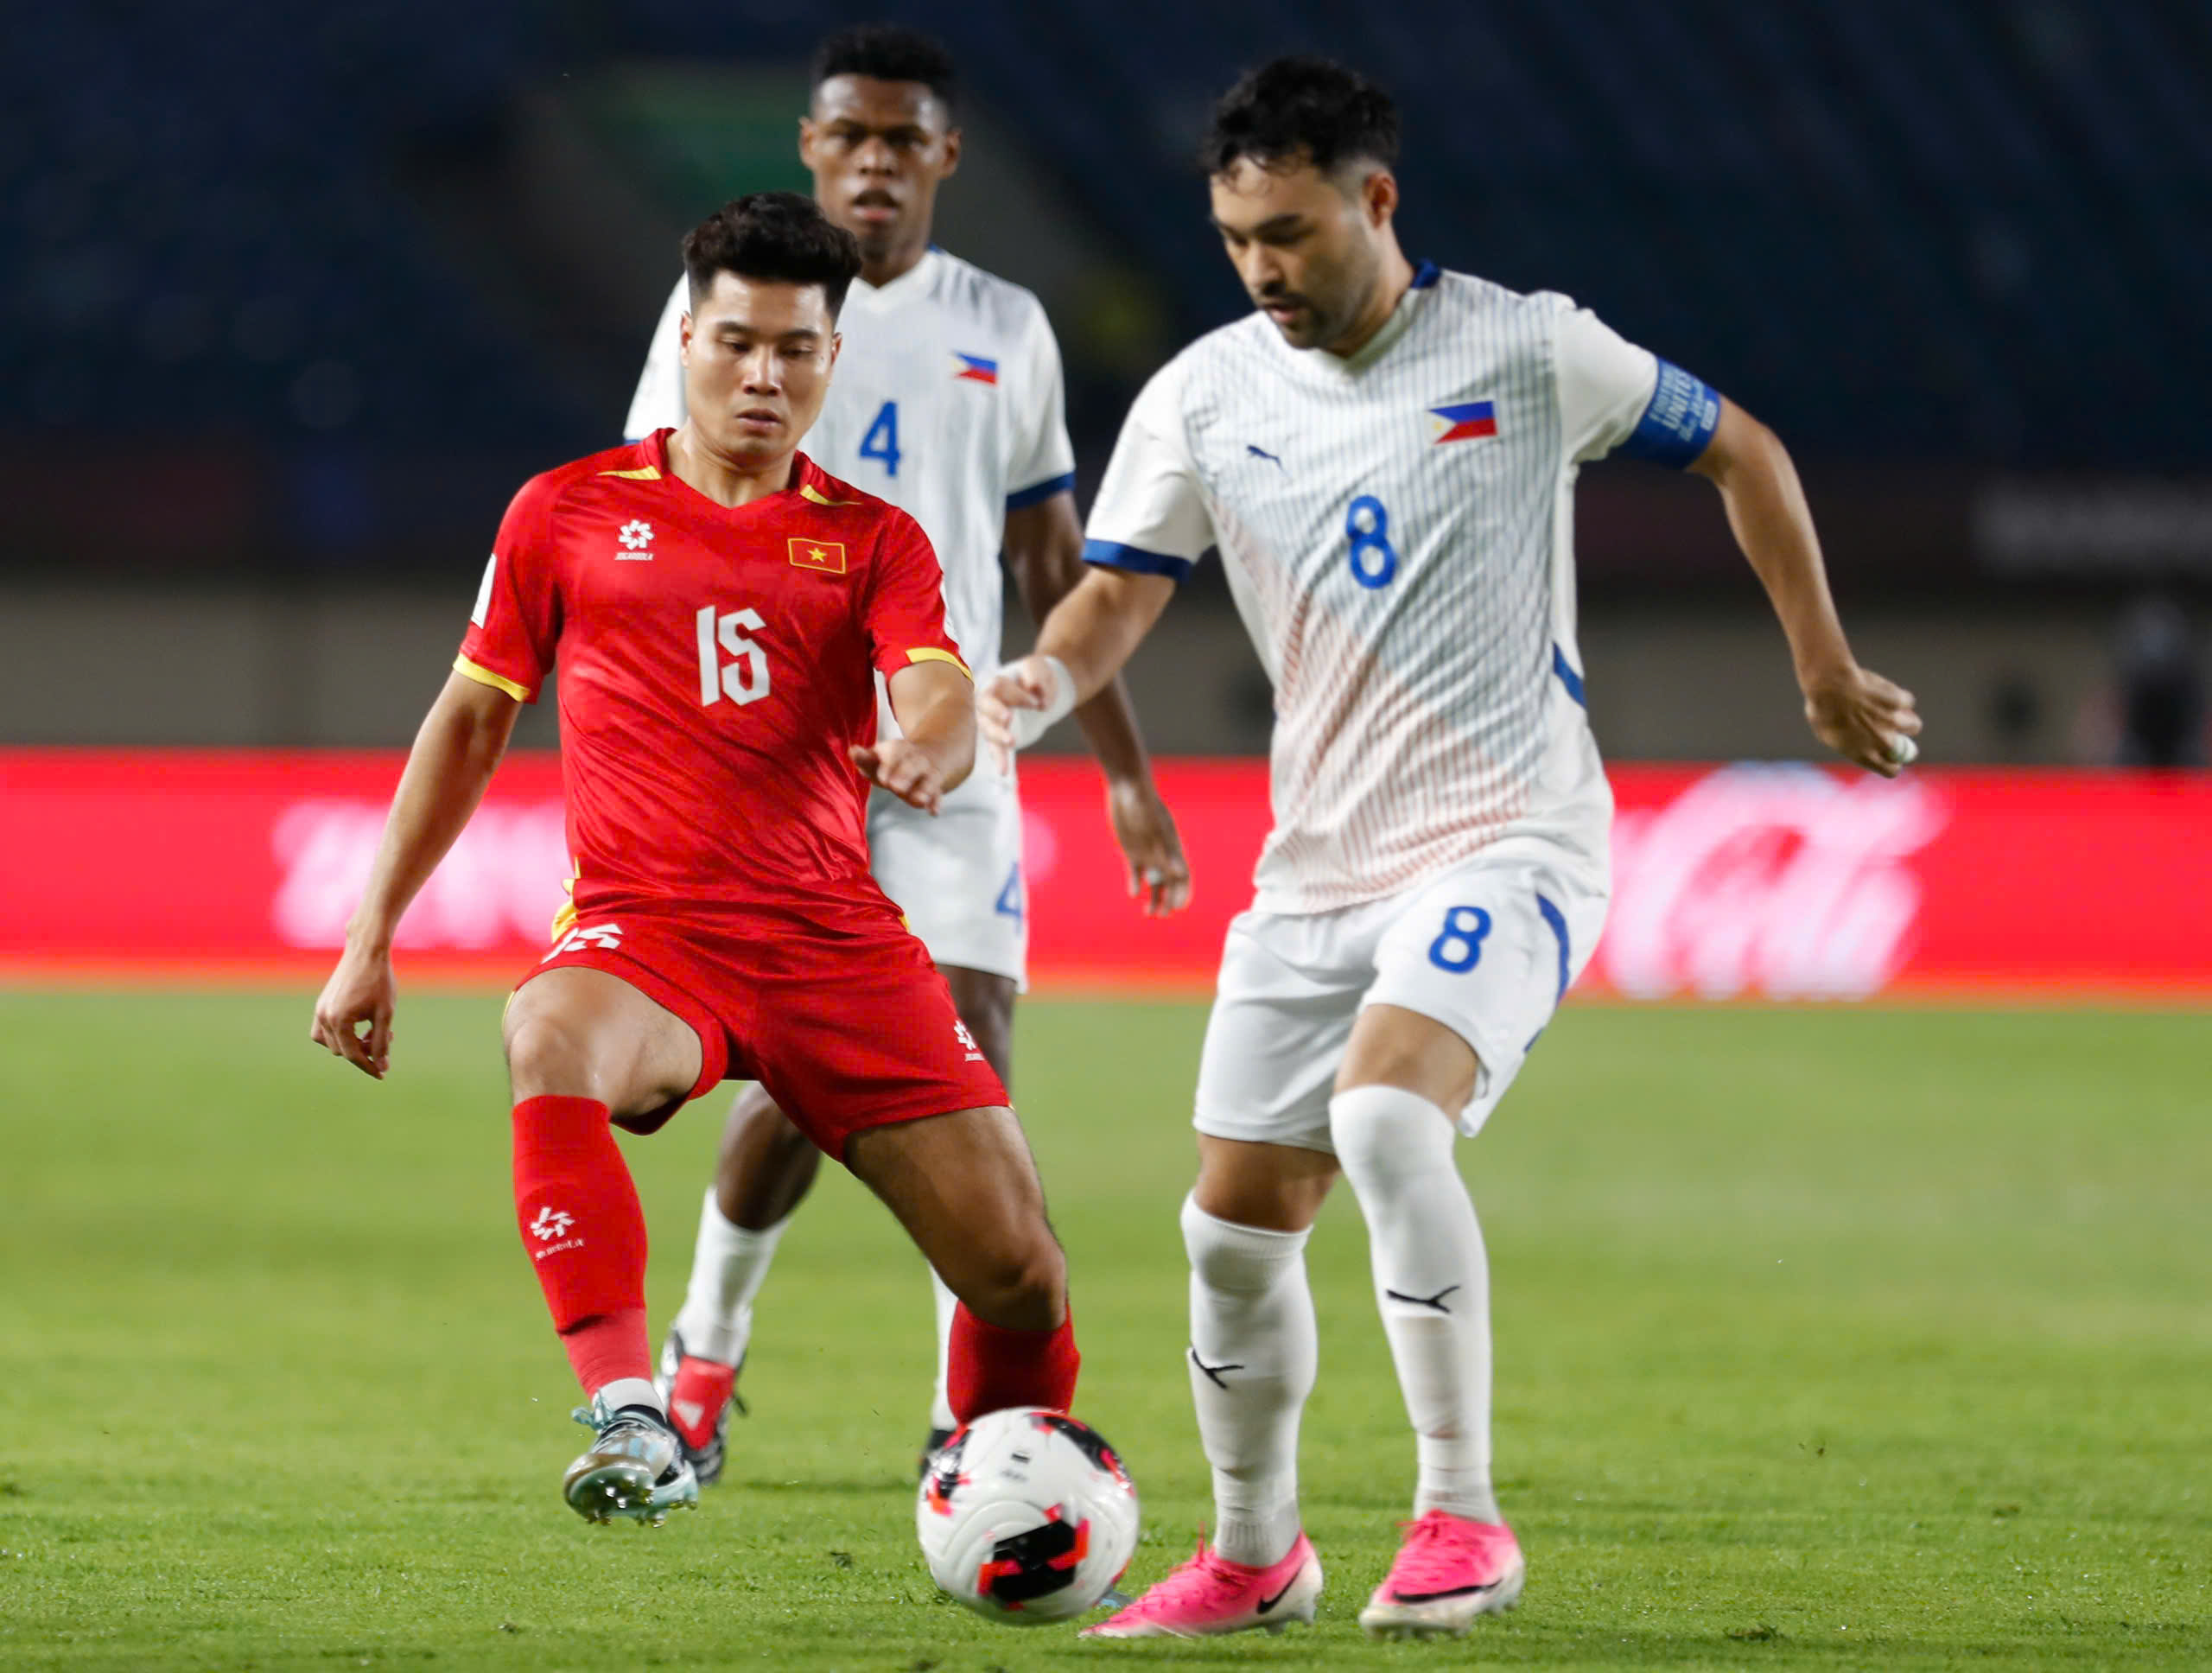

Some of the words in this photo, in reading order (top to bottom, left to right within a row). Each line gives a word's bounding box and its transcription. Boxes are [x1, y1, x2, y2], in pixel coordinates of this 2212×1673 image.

[859, 400, 901, 478] 4
[1345, 494, 1397, 589] 8
[696, 605, 771, 707] 15
[995, 861, 1023, 935] 4
[1427, 905, 1493, 976] 8
